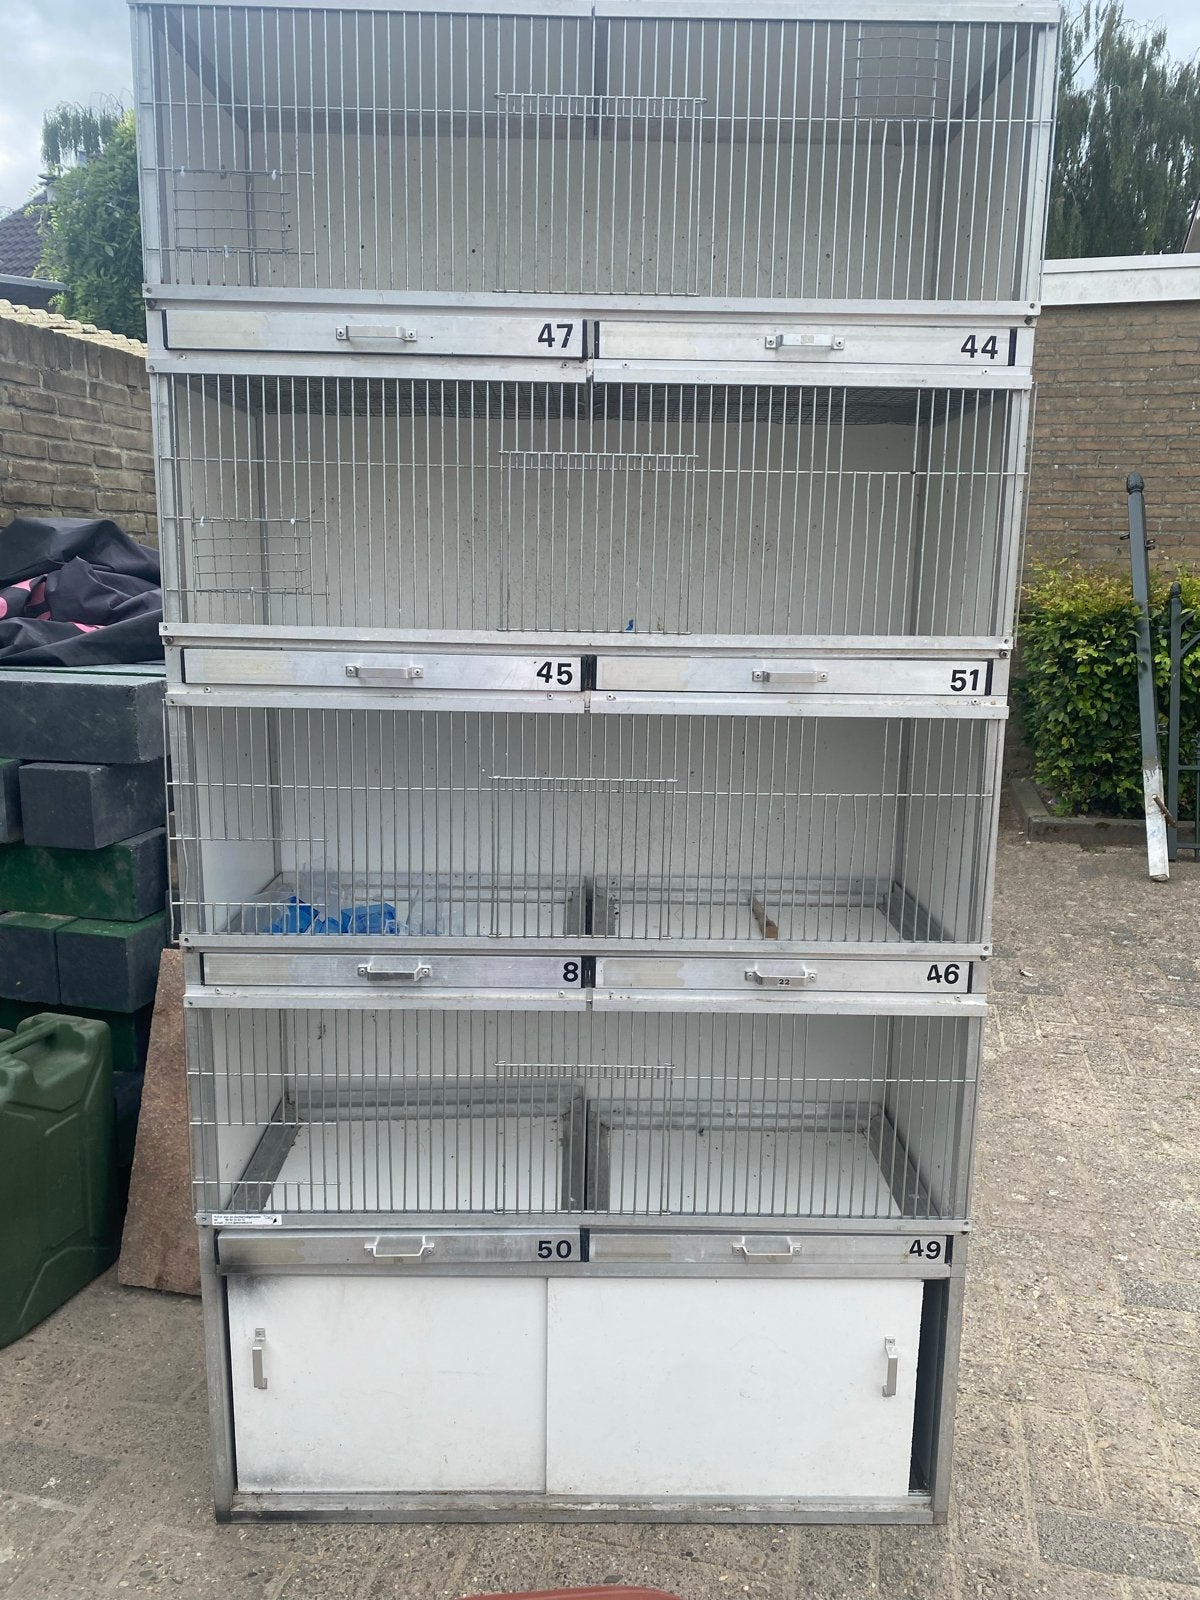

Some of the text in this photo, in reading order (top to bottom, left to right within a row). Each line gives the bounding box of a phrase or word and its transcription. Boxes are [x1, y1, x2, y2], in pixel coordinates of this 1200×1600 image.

[538, 323, 574, 349] 47
[961, 334, 998, 360] 44
[536, 661, 573, 686] 45
[950, 669, 980, 692] 51
[562, 961, 579, 983] 8
[778, 978, 791, 986] 22
[926, 963, 960, 985] 46
[537, 1239, 573, 1260] 50
[908, 1239, 942, 1260] 49
